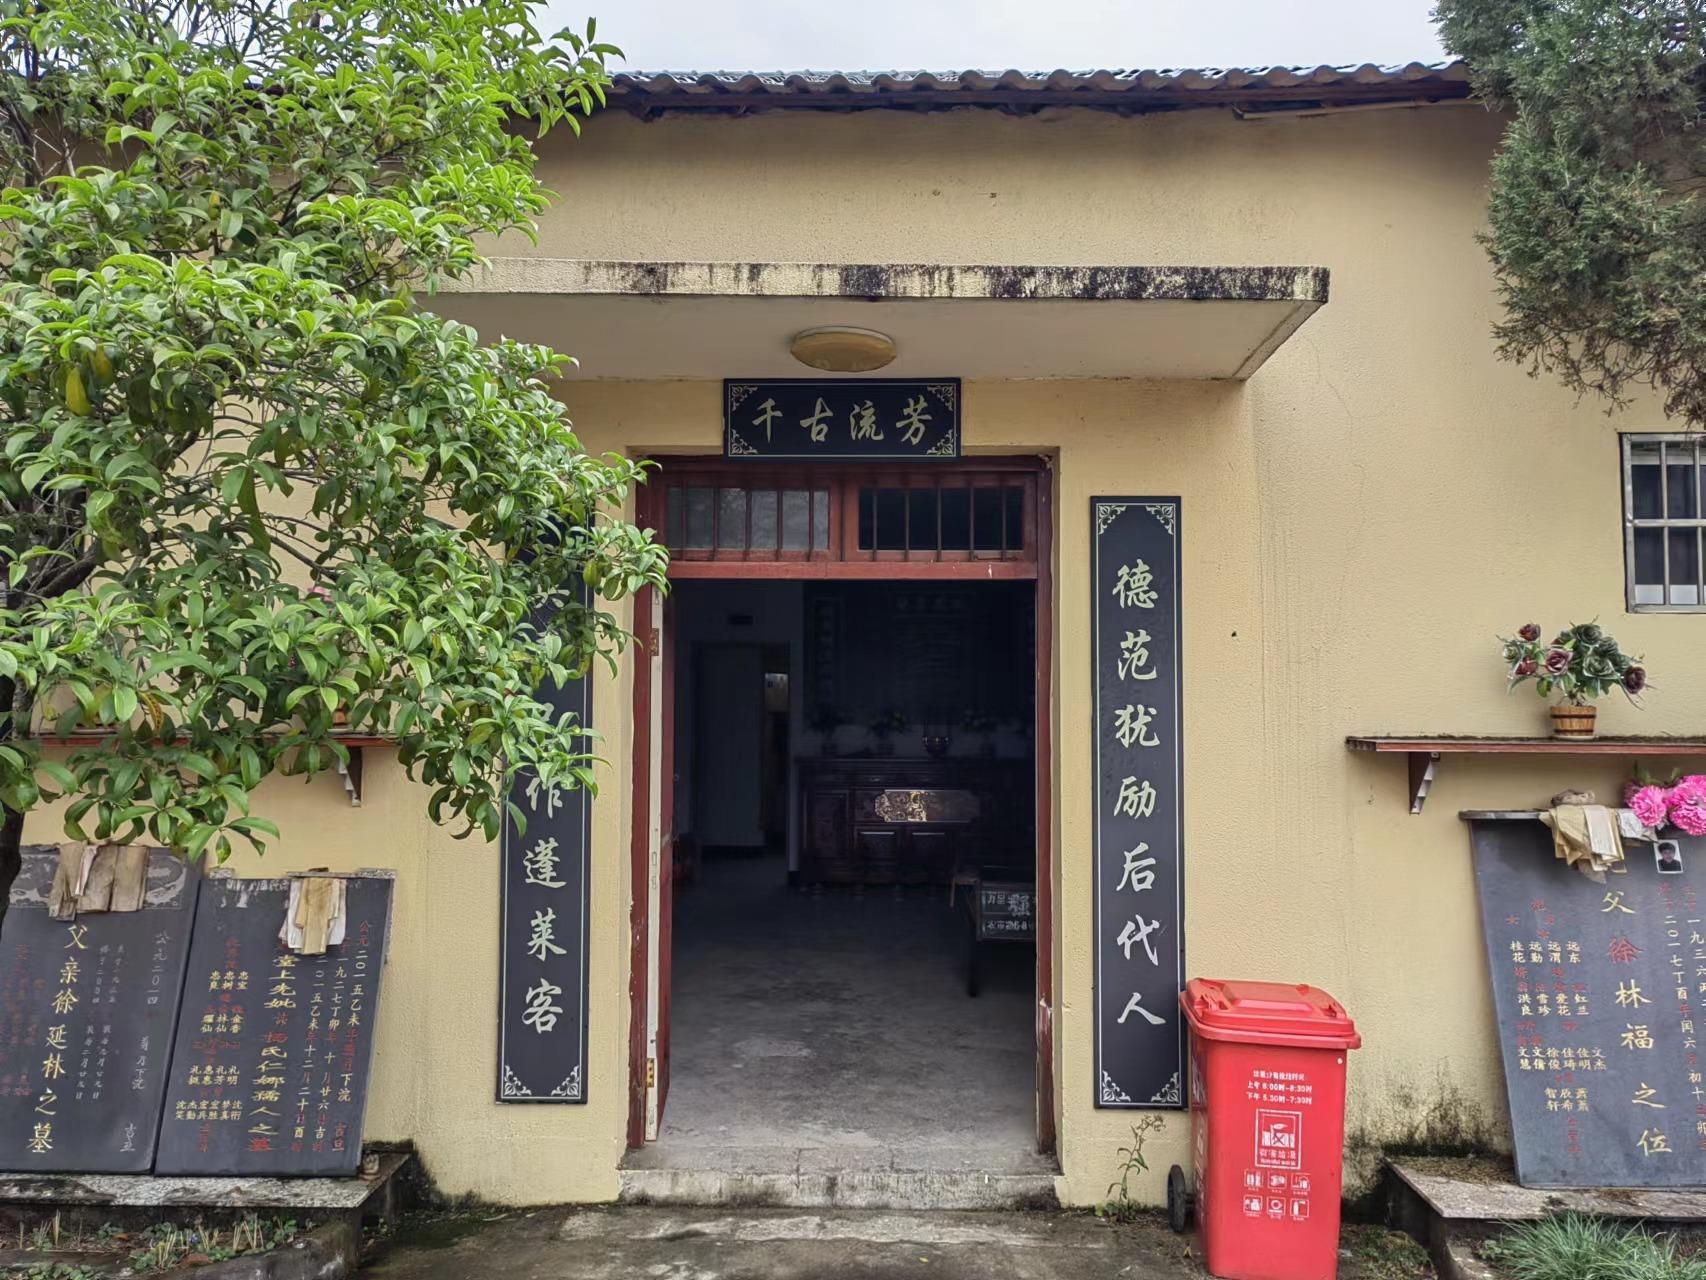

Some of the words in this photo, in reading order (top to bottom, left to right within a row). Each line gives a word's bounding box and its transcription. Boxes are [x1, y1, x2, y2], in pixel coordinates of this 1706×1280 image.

[751, 394, 933, 446] 千古流芳
[1111, 559, 1167, 1026] 德范犹励后代人
[26, 923, 89, 1154] 父亲徐延林之墓
[1601, 890, 1673, 1157] 父徐林福之位
